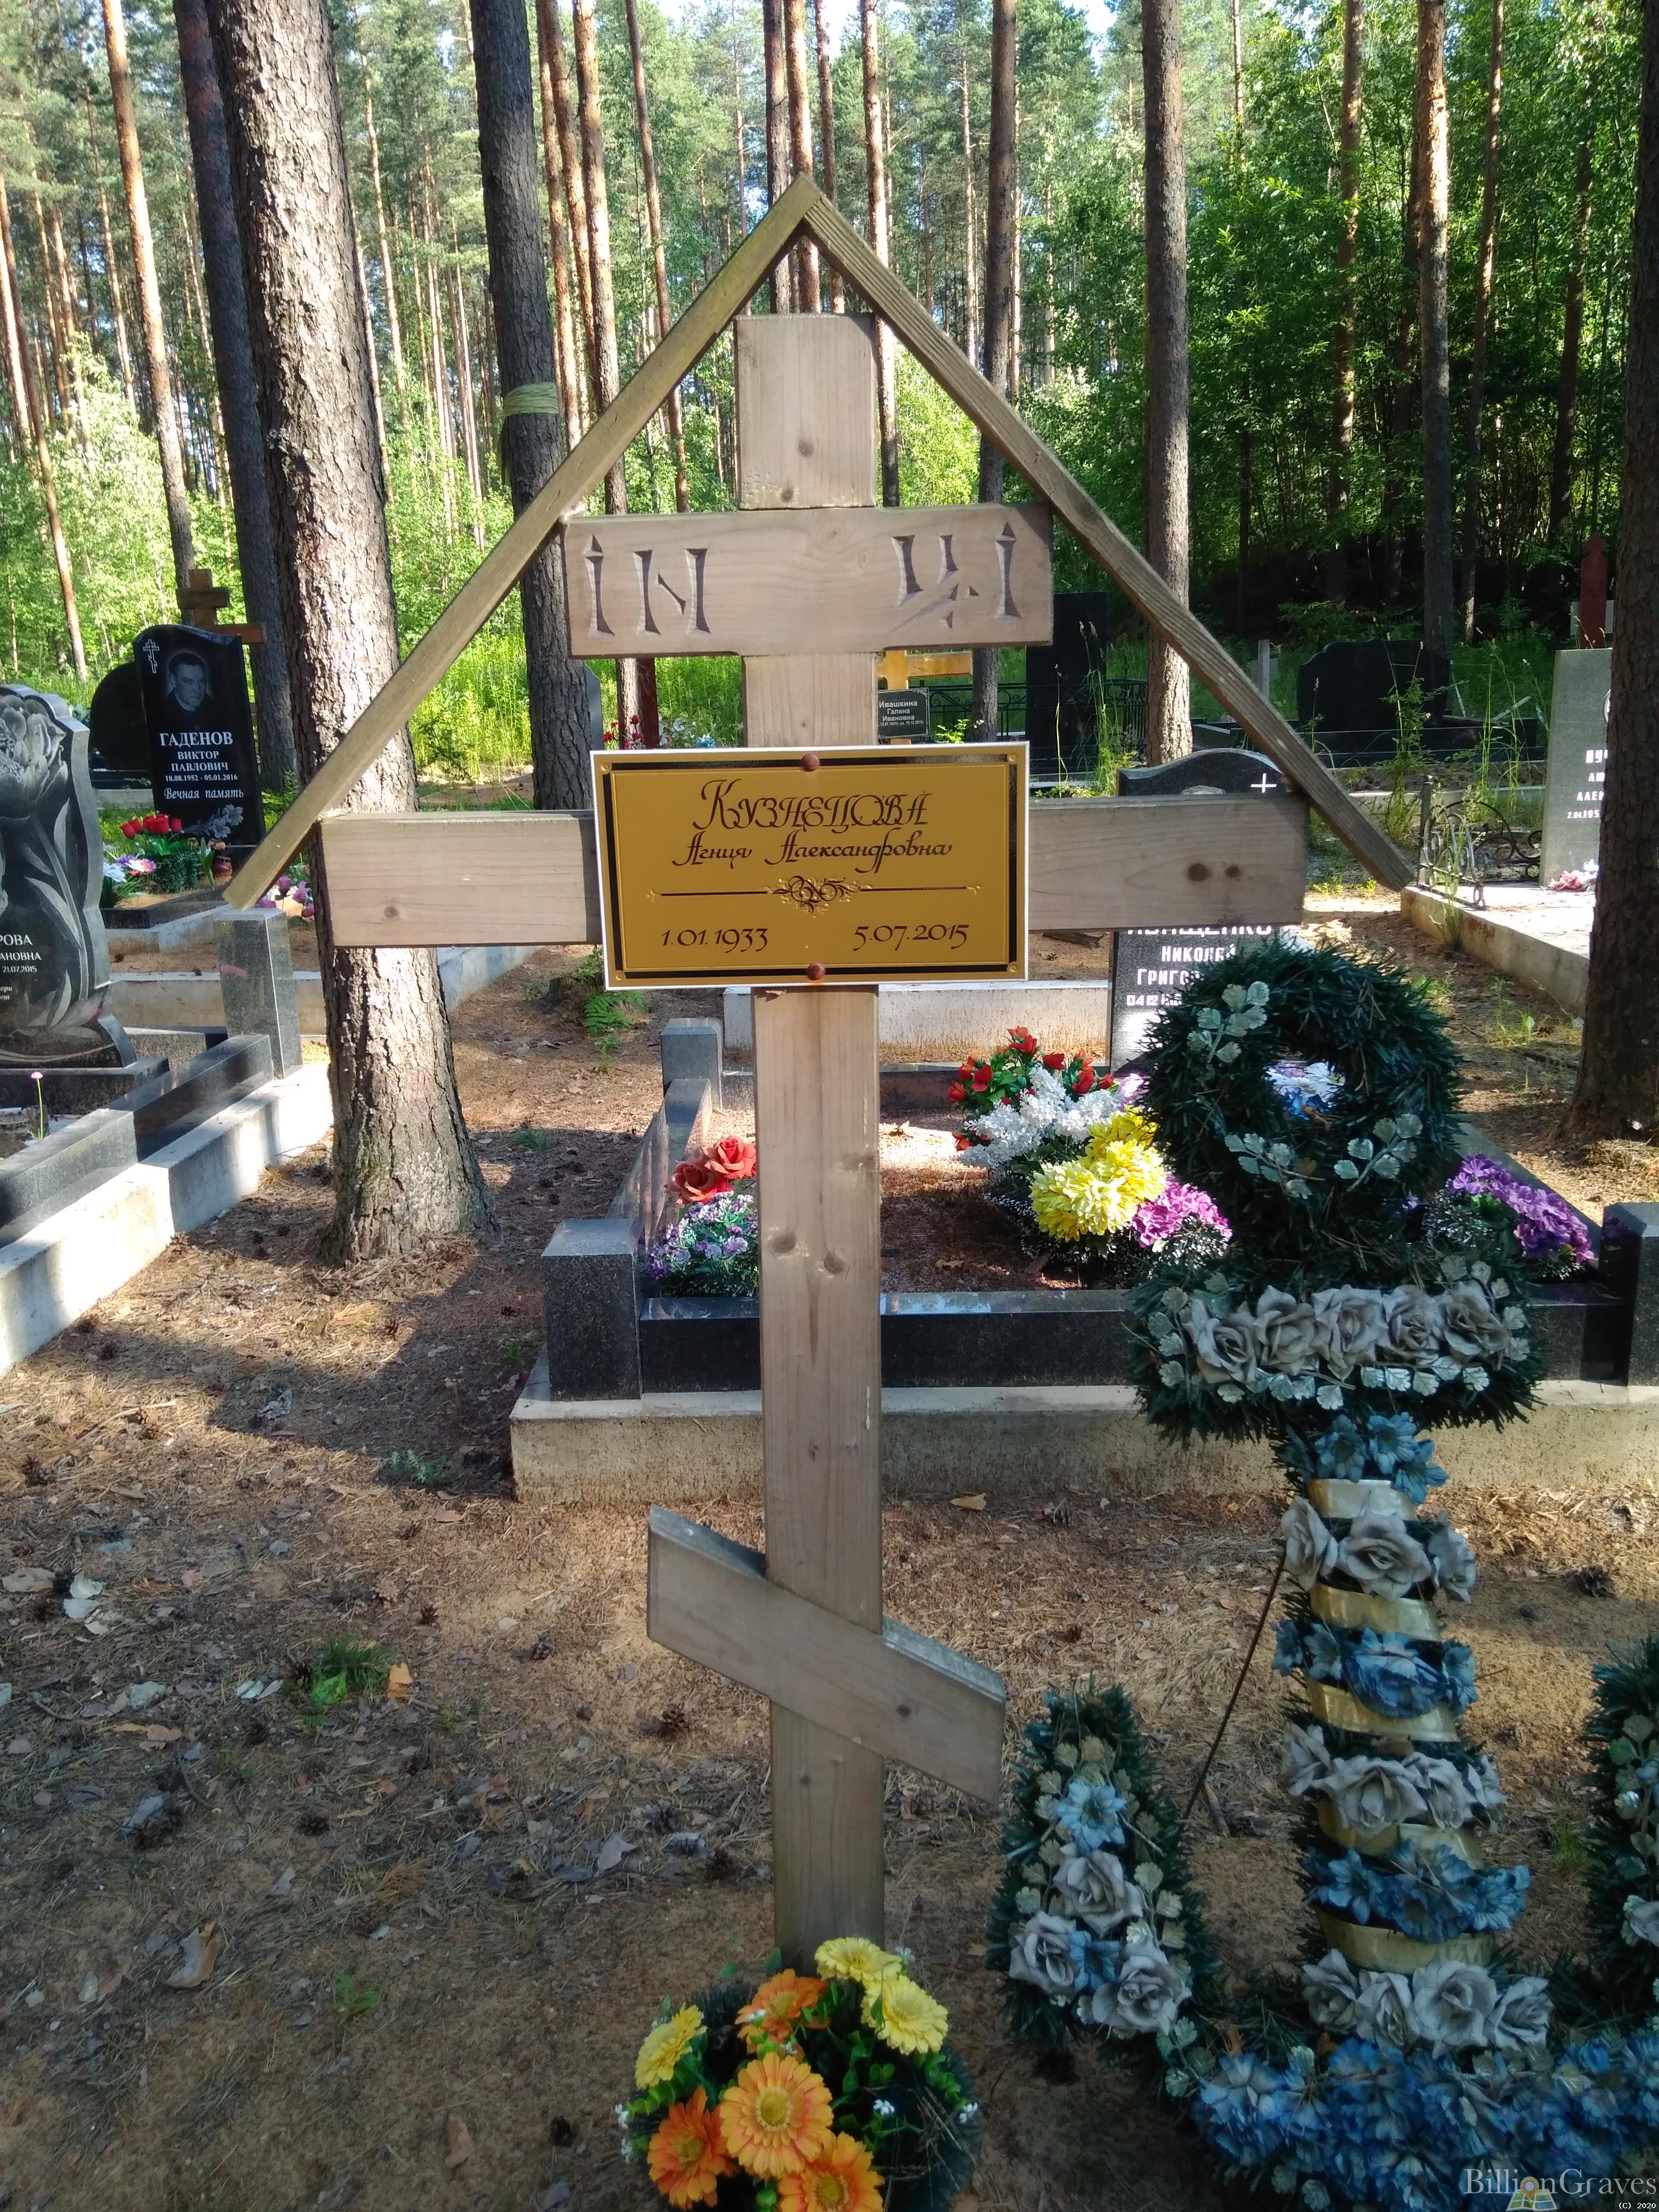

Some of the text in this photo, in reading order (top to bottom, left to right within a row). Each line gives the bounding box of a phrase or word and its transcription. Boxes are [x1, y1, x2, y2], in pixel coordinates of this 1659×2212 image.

[160, 732, 233, 748] ГАДЕНОВ
[177, 750, 219, 760] ВИКТОР
[171, 762, 229, 772] ПАВЛОВИЧ
[164, 787, 244, 799] Вечная память
[764, 826, 952, 874] Александровна
[661, 924, 969, 953] 1.01.1933 5.07.2015
